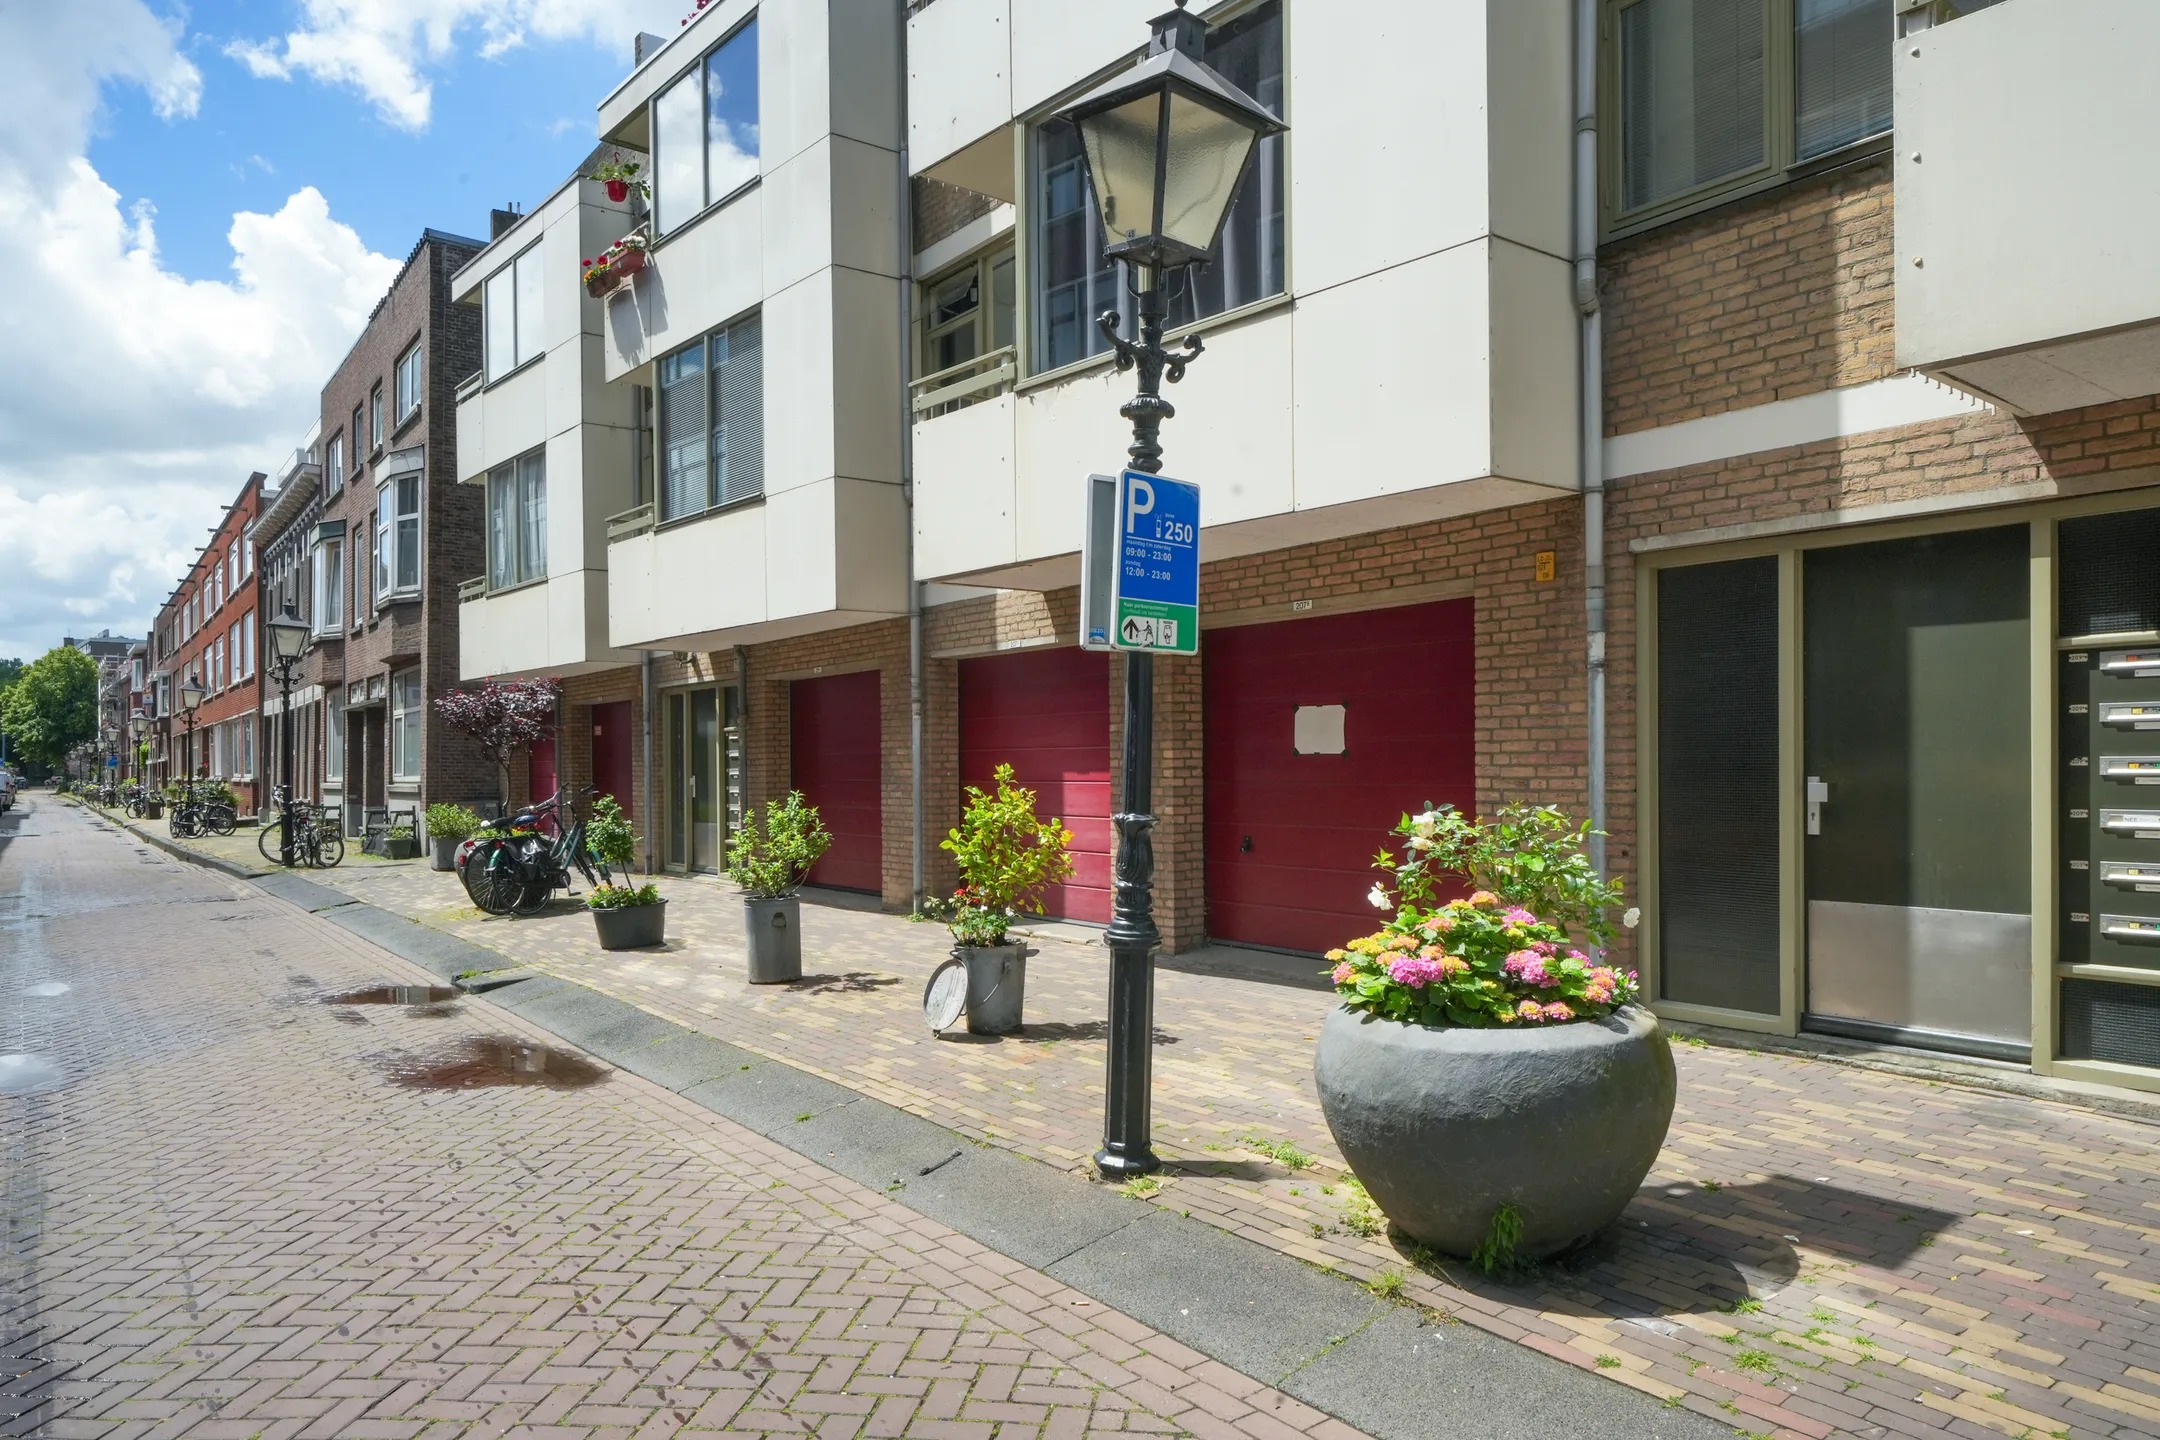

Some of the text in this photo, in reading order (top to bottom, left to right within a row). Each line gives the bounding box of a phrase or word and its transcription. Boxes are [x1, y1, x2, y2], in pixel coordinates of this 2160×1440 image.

[1127, 478, 1155, 534] P
[1164, 520, 1193, 543] 250
[1125, 547, 1146, 558] 09:00
[1152, 551, 1172, 562] 23:00
[1125, 566, 1145, 577] 12:00
[1151, 570, 1171, 581] 23:00
